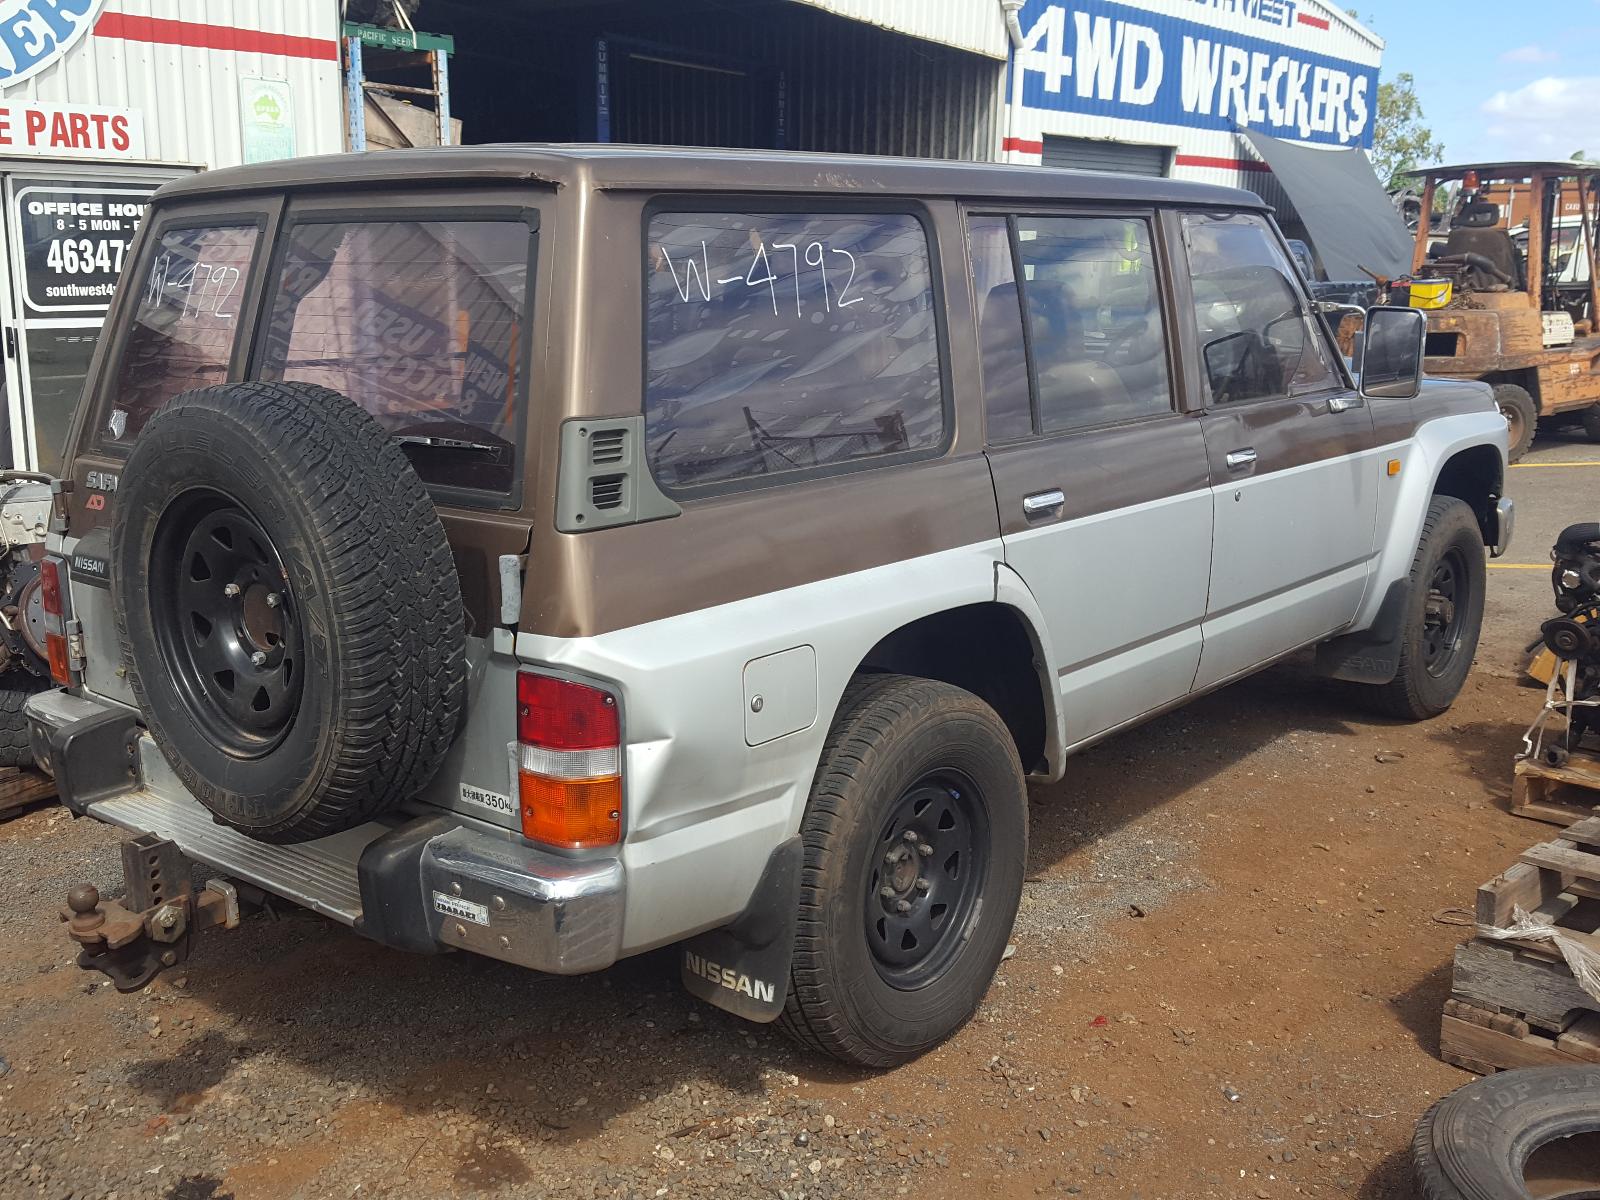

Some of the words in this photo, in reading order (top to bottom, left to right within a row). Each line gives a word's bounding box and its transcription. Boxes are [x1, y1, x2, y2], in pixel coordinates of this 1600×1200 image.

[0, 0, 92, 80] ER
[357, 29, 387, 42] PACIFIC
[1023, 5, 1164, 106] 4WD
[1181, 35, 1368, 143] WRECKERS
[25, 109, 130, 152] PARTS
[28, 202, 103, 216] OFFICE
[109, 203, 147, 217] HOU
[56, 219, 65, 231] 8
[78, 219, 86, 231] 5
[91, 219, 120, 231] MON
[148, 255, 239, 318] W-4792
[662, 240, 864, 319] W-4792
[86, 471, 120, 491] SAFA
[74, 556, 104, 574] NISSAN
[686, 951, 775, 1003] NISSAN
